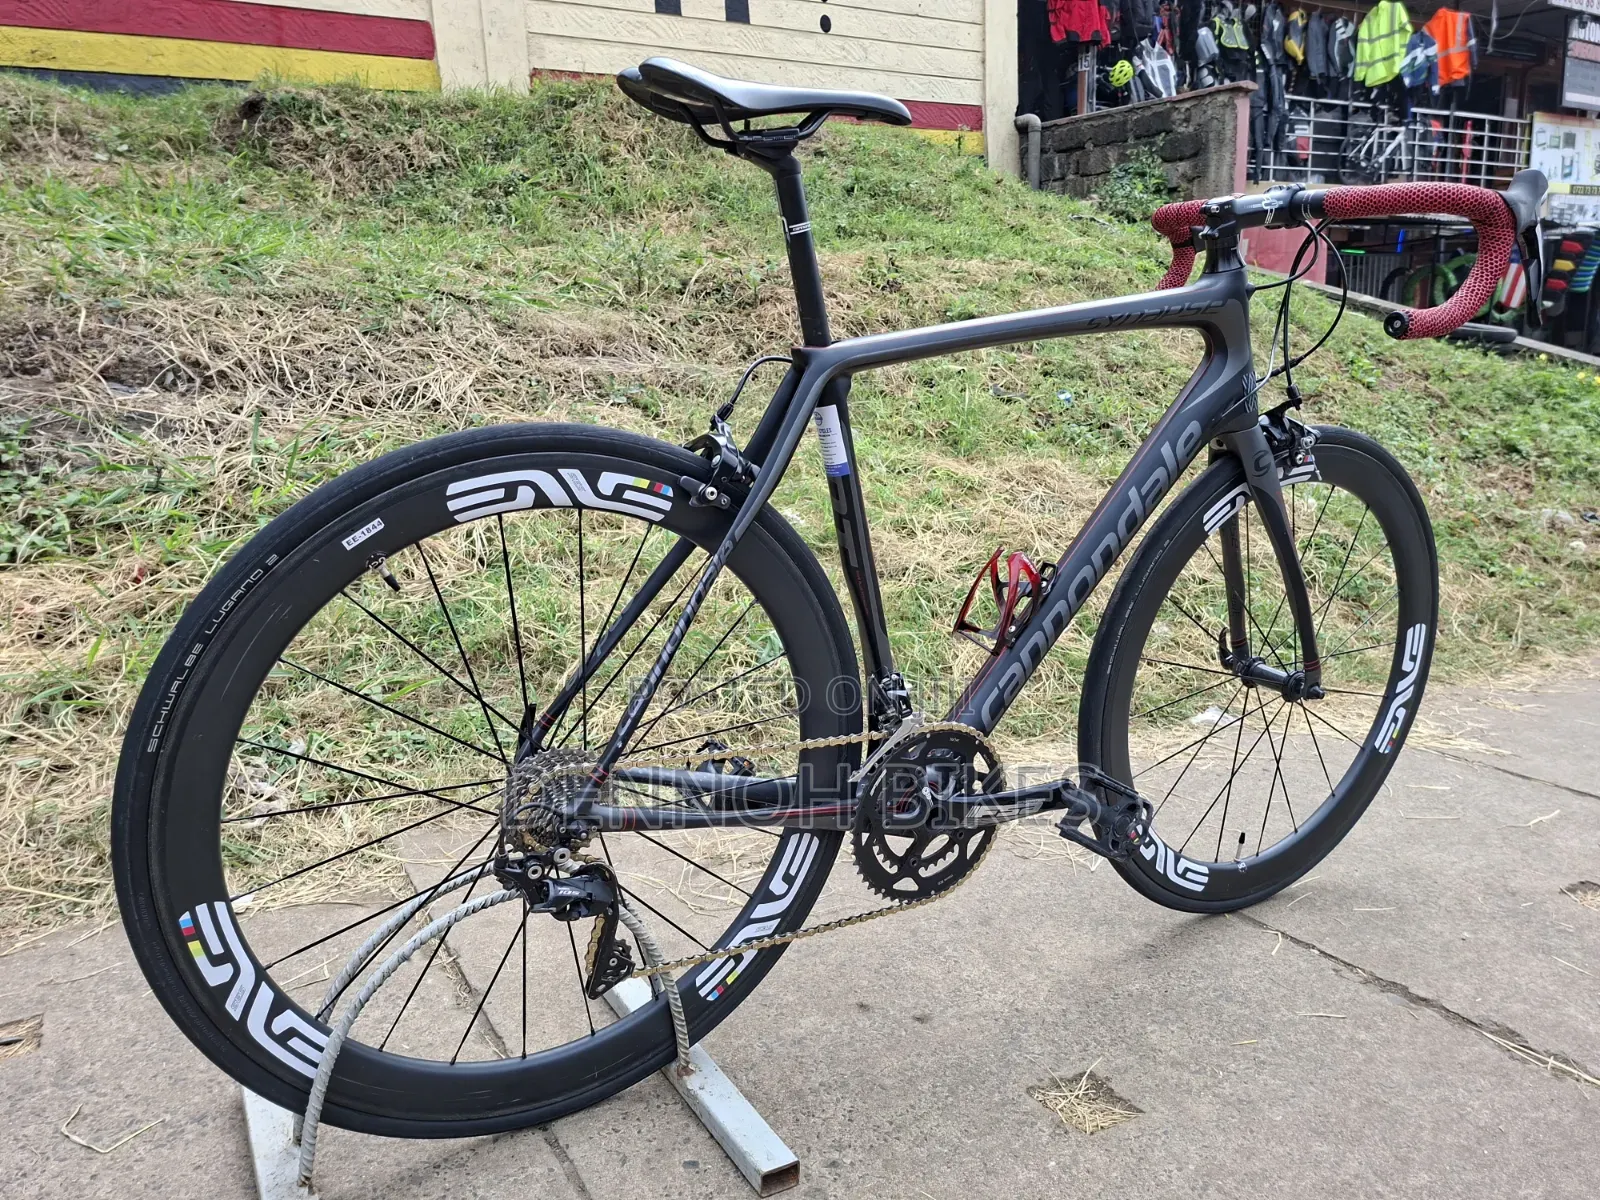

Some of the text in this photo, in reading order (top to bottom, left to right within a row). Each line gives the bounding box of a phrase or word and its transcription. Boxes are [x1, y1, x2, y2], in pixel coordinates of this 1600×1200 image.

[344, 519, 383, 547] EE-1844
[446, 468, 674, 523] ENVE
[980, 420, 1202, 732] cannondale
[147, 642, 204, 753] SCHWALBE
[204, 568, 264, 635] LUGANO
